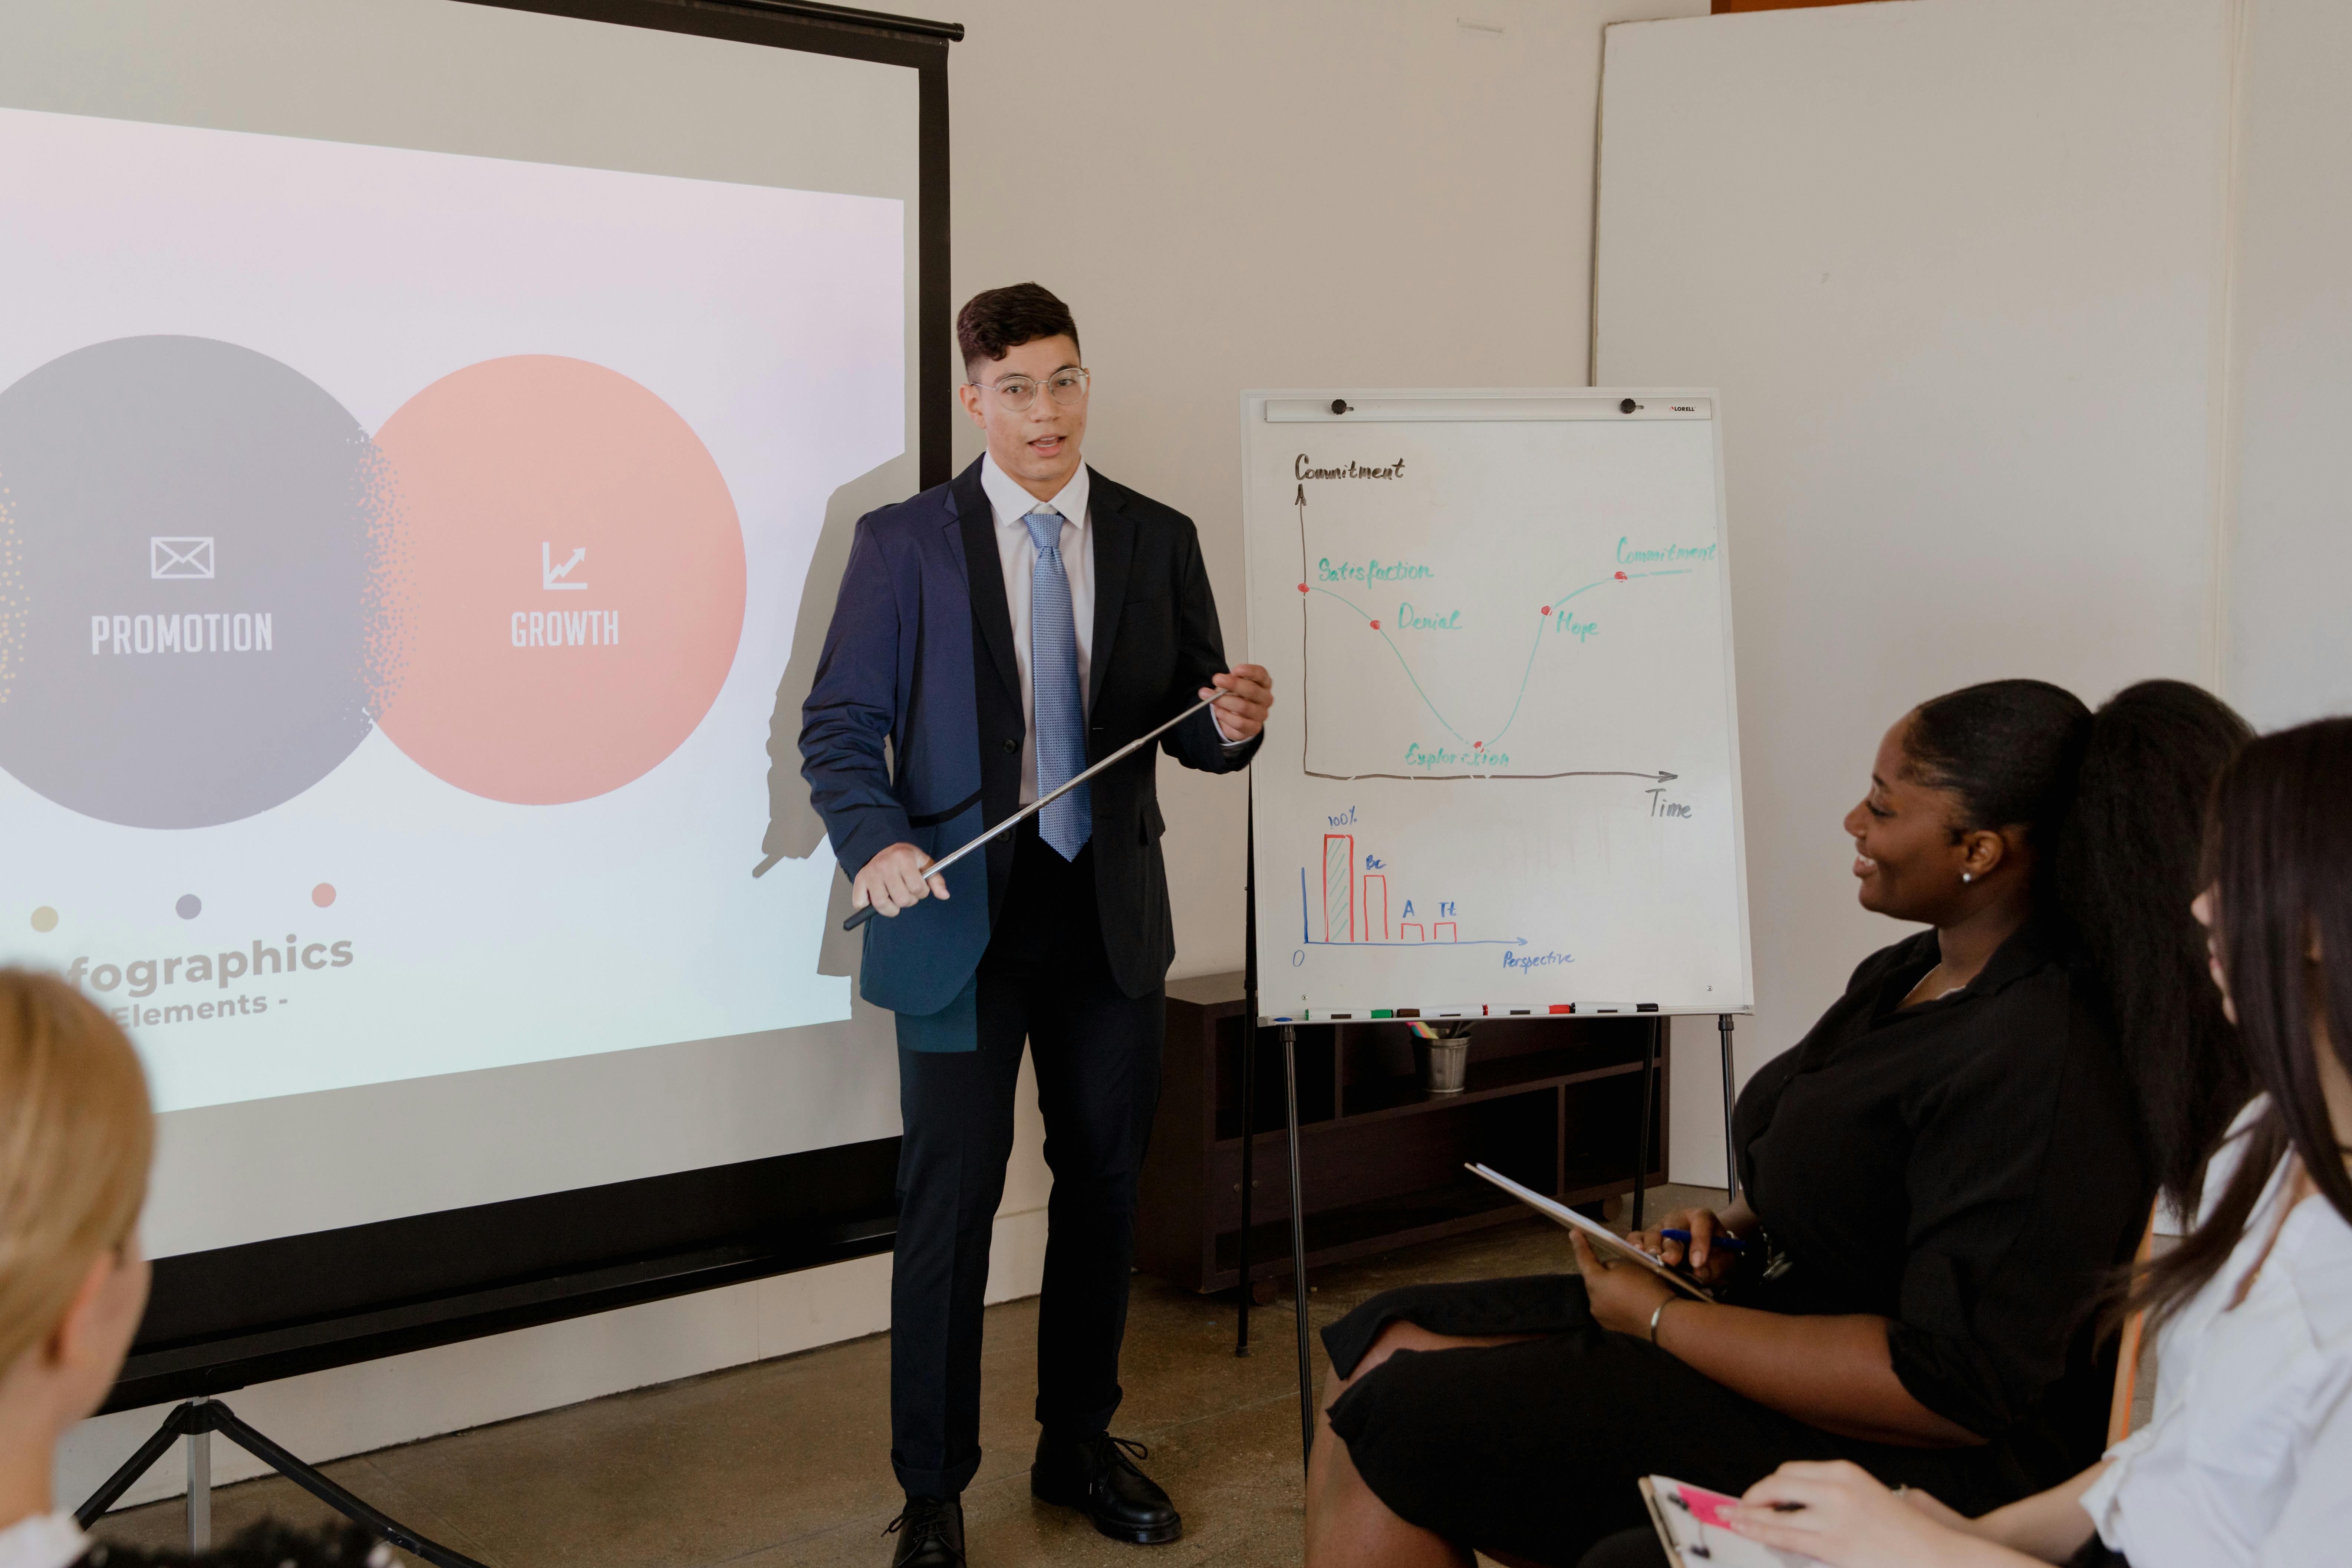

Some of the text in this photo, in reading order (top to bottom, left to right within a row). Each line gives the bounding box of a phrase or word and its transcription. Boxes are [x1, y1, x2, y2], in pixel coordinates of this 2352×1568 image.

[1295, 454, 1405, 480] Commitment
[1617, 536, 1716, 564] Commitment
[1319, 558, 1434, 590] Satisfaction
[511, 610, 619, 647] GROWTH
[1398, 602, 1462, 630] Denial
[1556, 610, 1599, 643] Hope
[92, 613, 272, 655] PROMOTION
[1328, 806, 1357, 829] 100%
[1645, 788, 1692, 819] Time
[1403, 900, 1415, 918] A
[68, 933, 353, 998] fographics
[1503, 951, 1575, 974] Perspective
